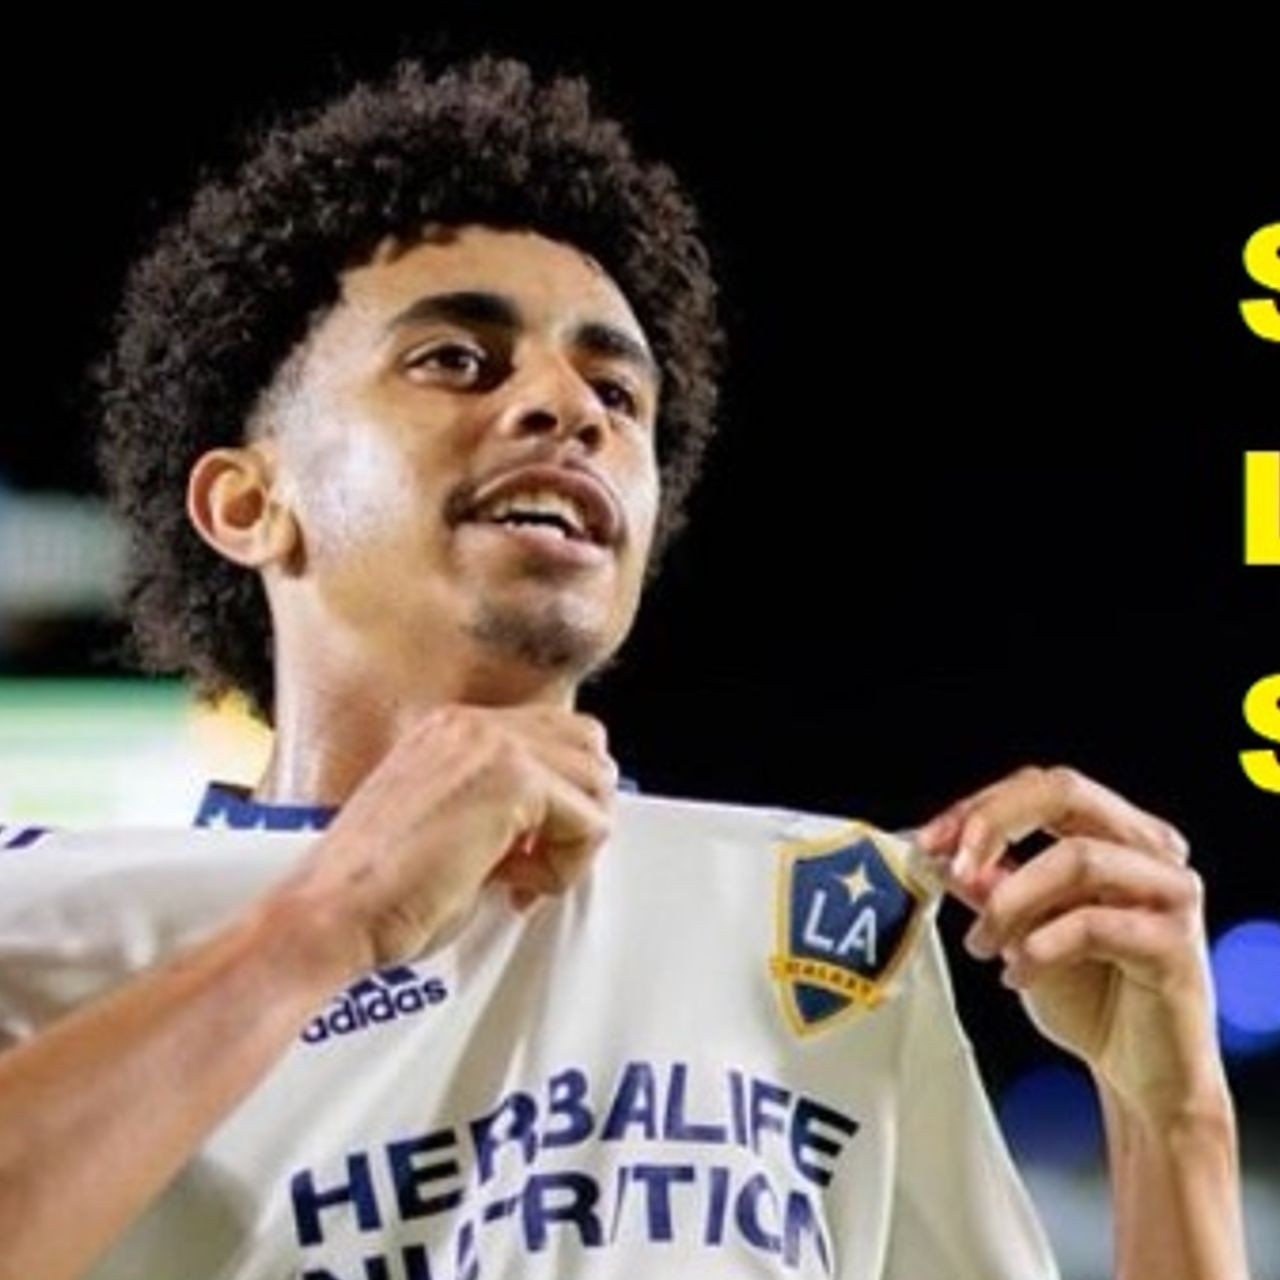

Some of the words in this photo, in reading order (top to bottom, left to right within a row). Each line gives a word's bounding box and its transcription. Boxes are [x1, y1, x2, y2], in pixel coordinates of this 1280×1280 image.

[803, 889, 877, 966] LA
[301, 979, 448, 1043] adidas
[291, 1061, 858, 1248] HERBALIFE
